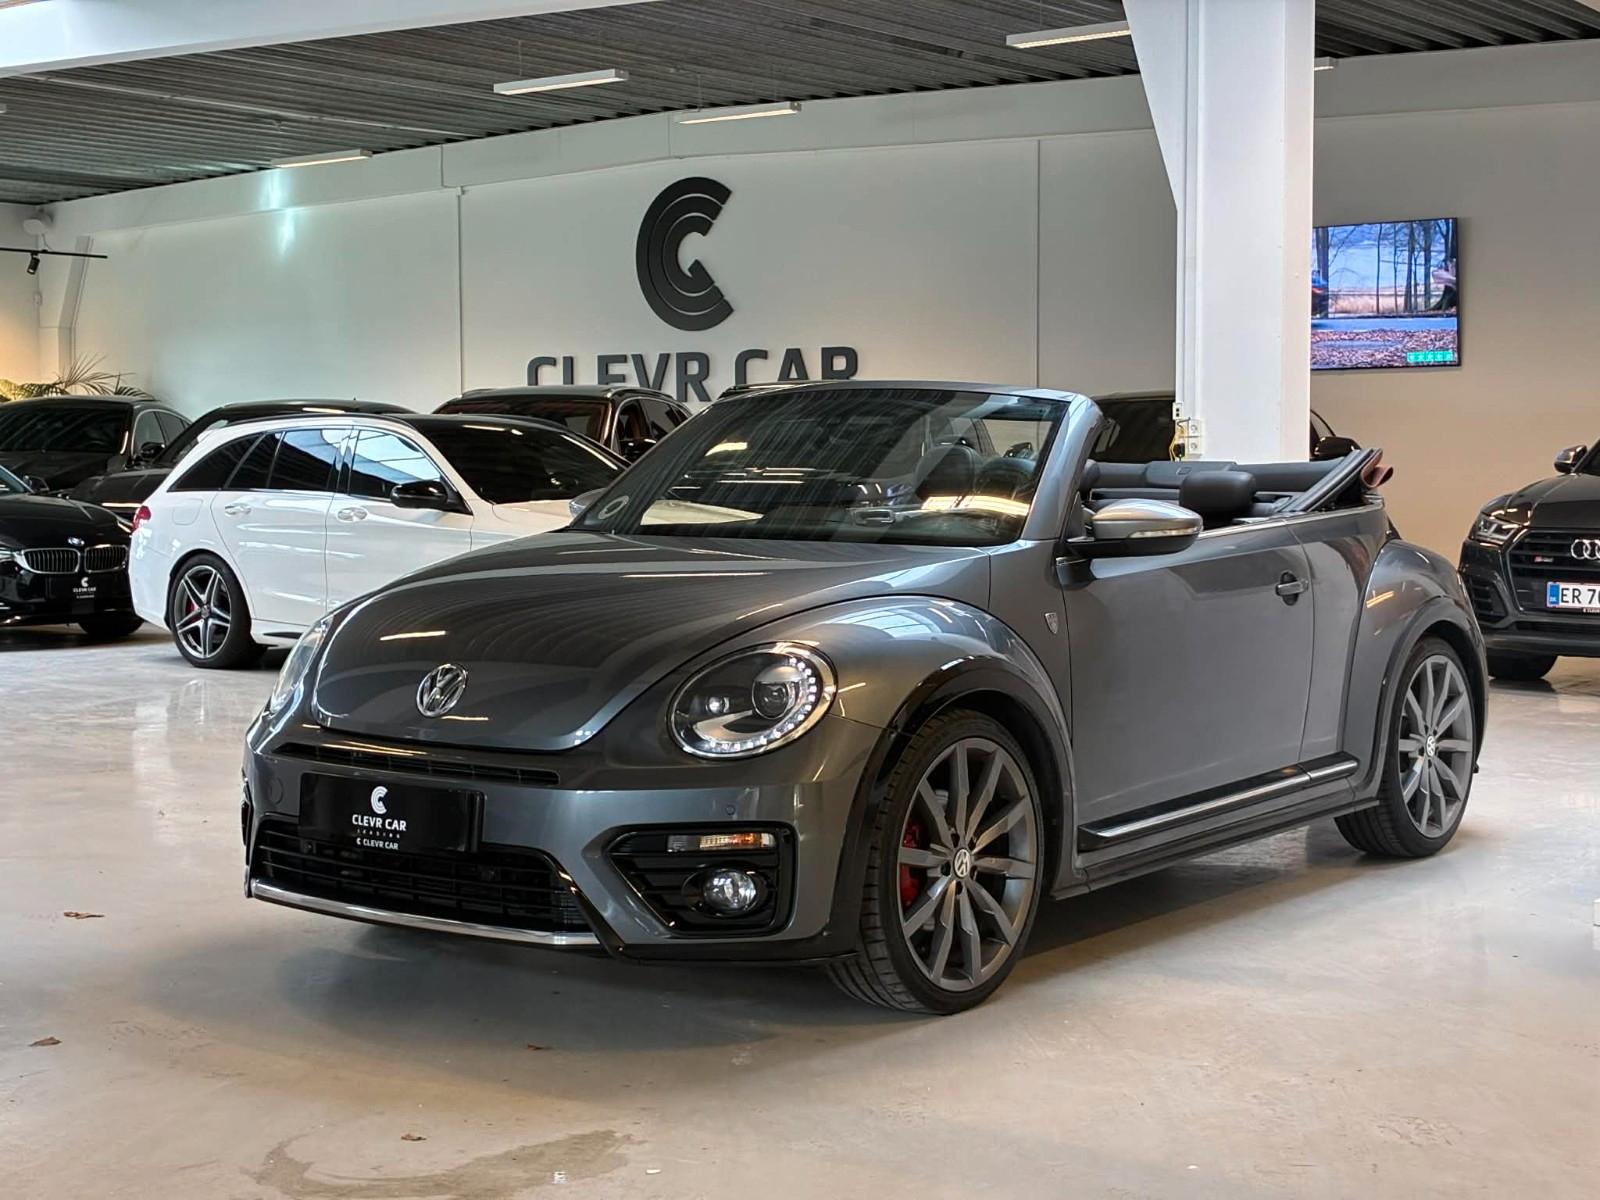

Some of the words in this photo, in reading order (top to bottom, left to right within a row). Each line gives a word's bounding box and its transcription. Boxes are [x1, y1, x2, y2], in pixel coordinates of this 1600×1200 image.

[734, 347, 858, 385] CAR
[1561, 588, 1582, 603] ER
[1587, 589, 1600, 605] 7
[352, 814, 382, 828] CLEVR
[385, 819, 406, 831] CAR
[363, 838, 384, 848] CLEVR
[385, 842, 398, 850] CAR
